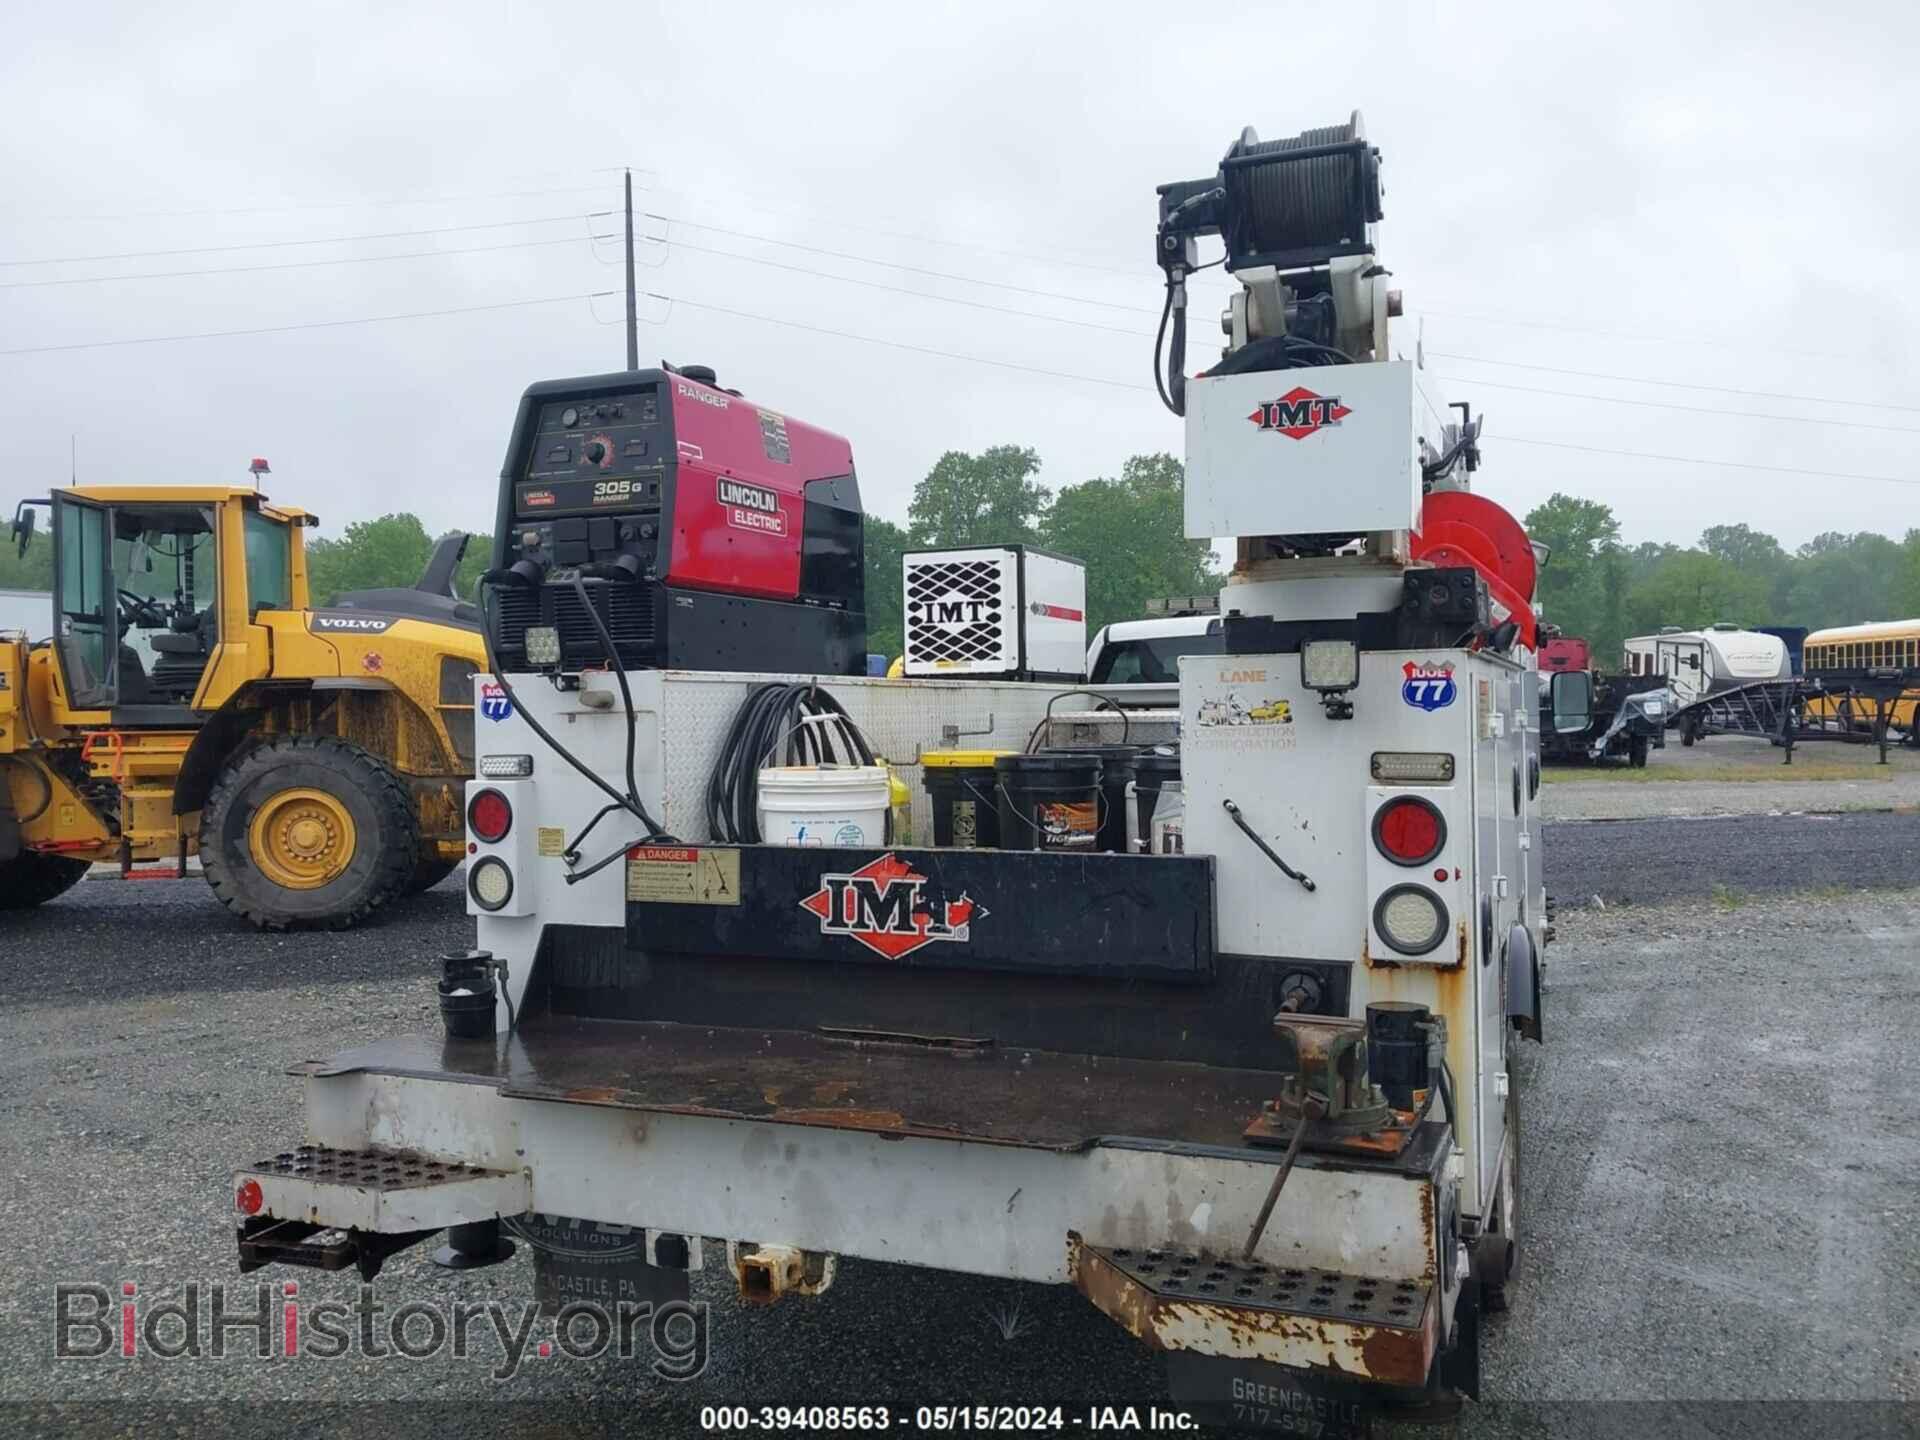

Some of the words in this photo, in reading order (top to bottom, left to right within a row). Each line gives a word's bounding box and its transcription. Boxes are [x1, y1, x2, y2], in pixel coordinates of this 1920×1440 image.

[678, 384, 729, 409] RANGER
[1259, 396, 1341, 431] IMT
[592, 494, 630, 504] RANGER
[720, 483, 776, 512] LINCOLN
[734, 510, 782, 531] ELECTRIC
[924, 601, 984, 624] IMT
[319, 618, 386, 629] VOLVO
[1220, 670, 1266, 683] LANE
[486, 688, 505, 697] IUO
[1411, 680, 1447, 701] 77
[486, 698, 508, 714] 77
[647, 849, 689, 860] DANGER
[534, 1226, 622, 1247] SOLUTIONS
[619, 1279, 637, 1299] PA
